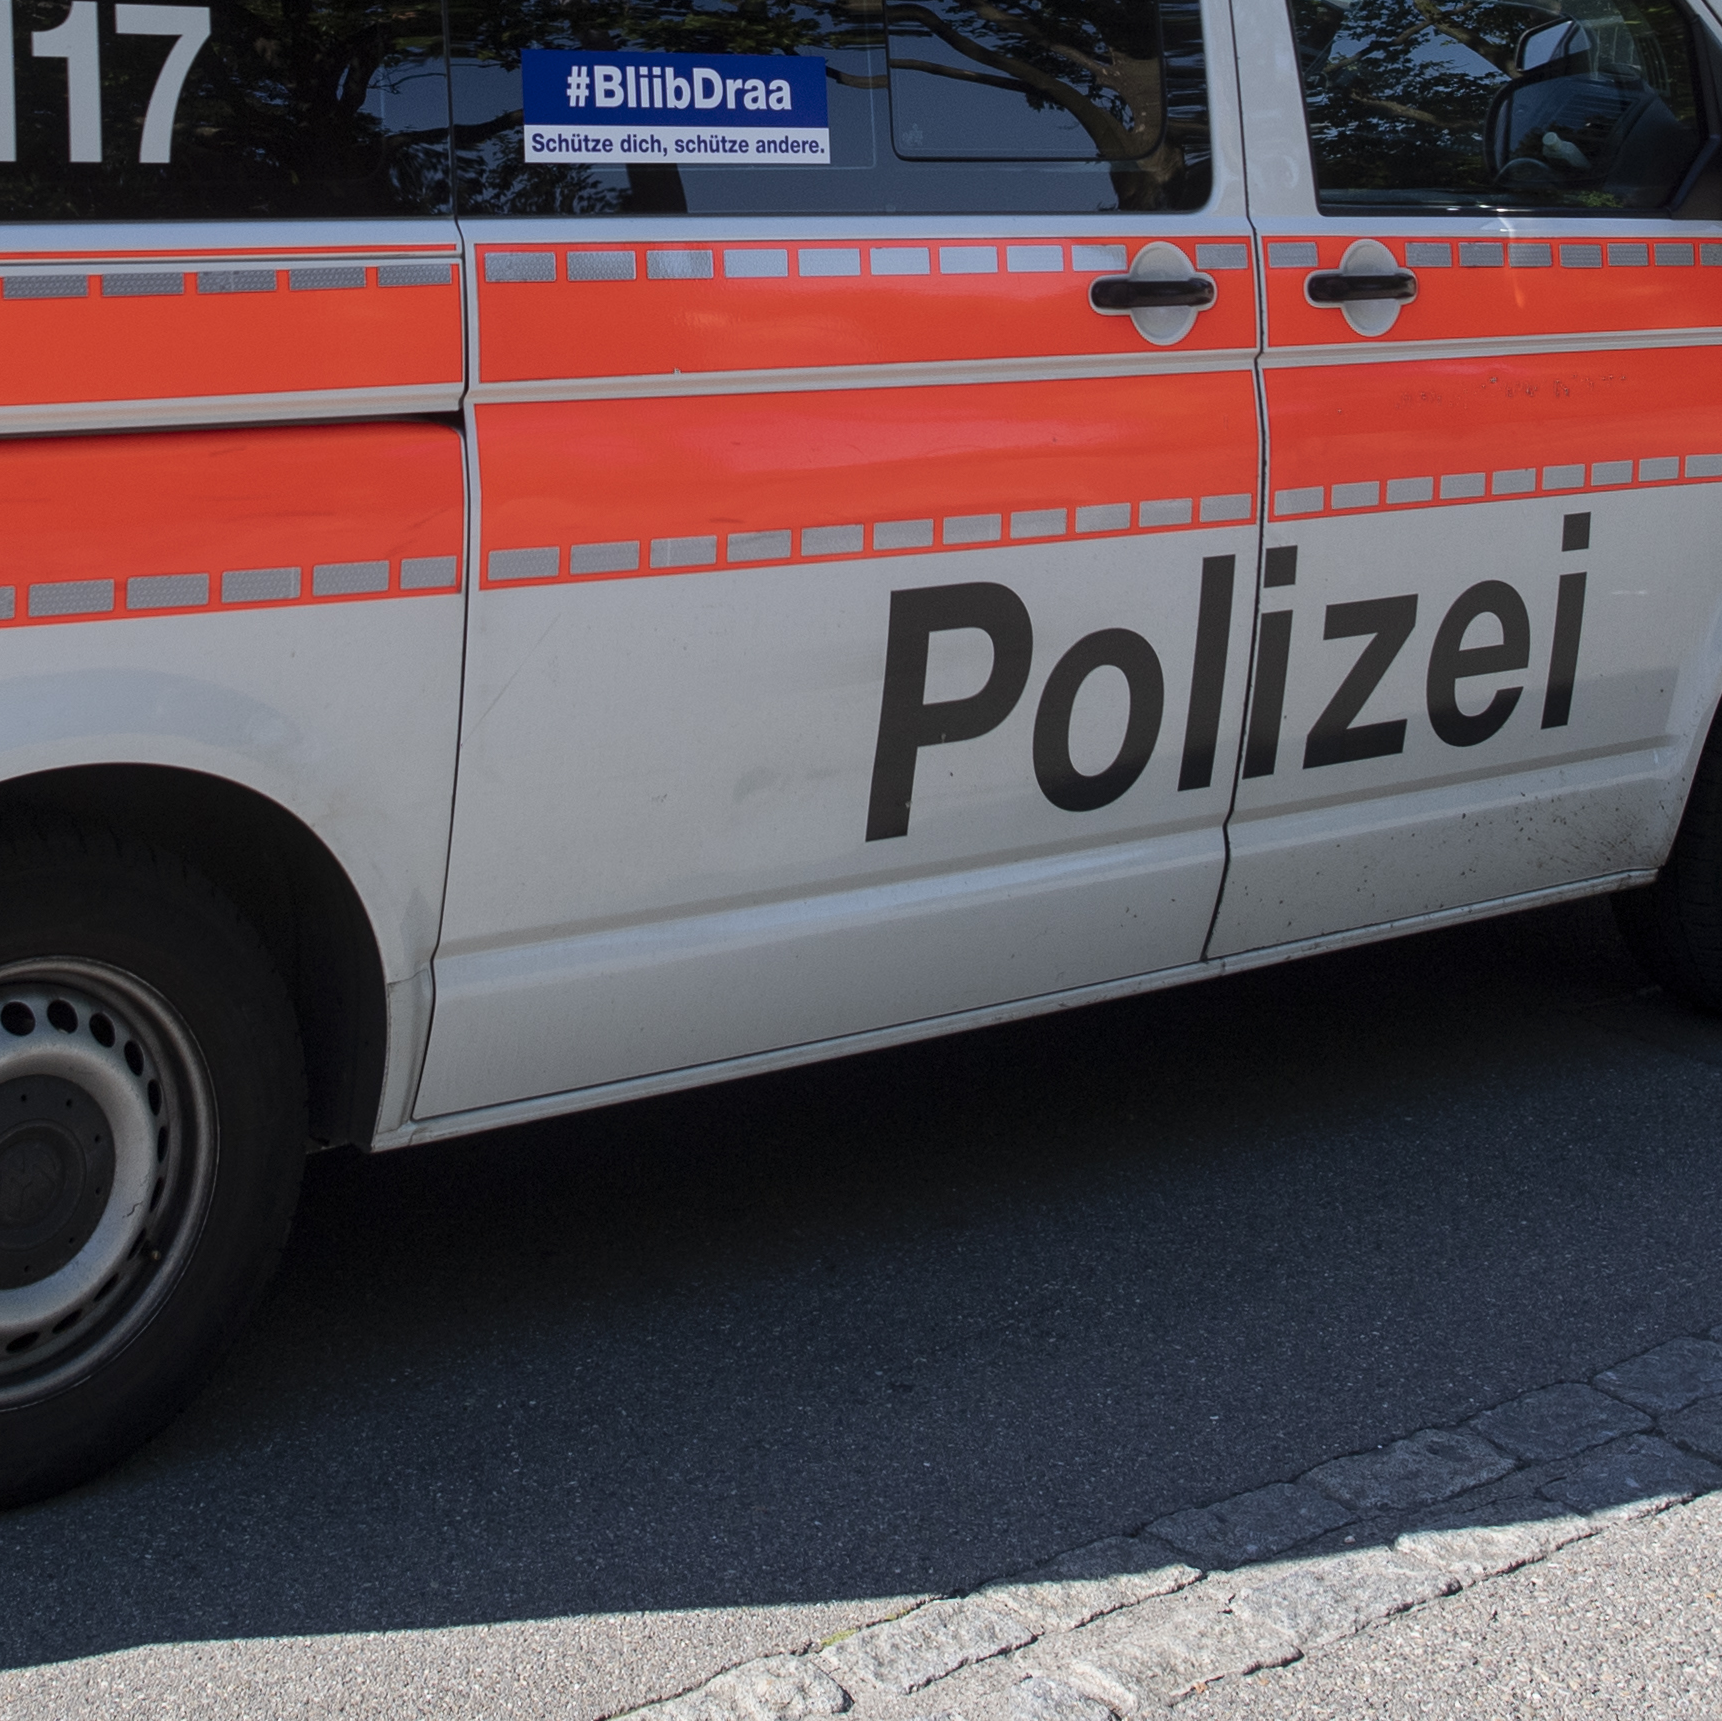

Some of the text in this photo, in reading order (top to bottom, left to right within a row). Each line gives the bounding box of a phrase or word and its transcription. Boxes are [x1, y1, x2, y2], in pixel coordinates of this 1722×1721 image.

[567, 65, 792, 110] #BliibDraa
[531, 132, 825, 157] Schütze dich, schütze andere.
[865, 512, 1591, 842] Polizei
